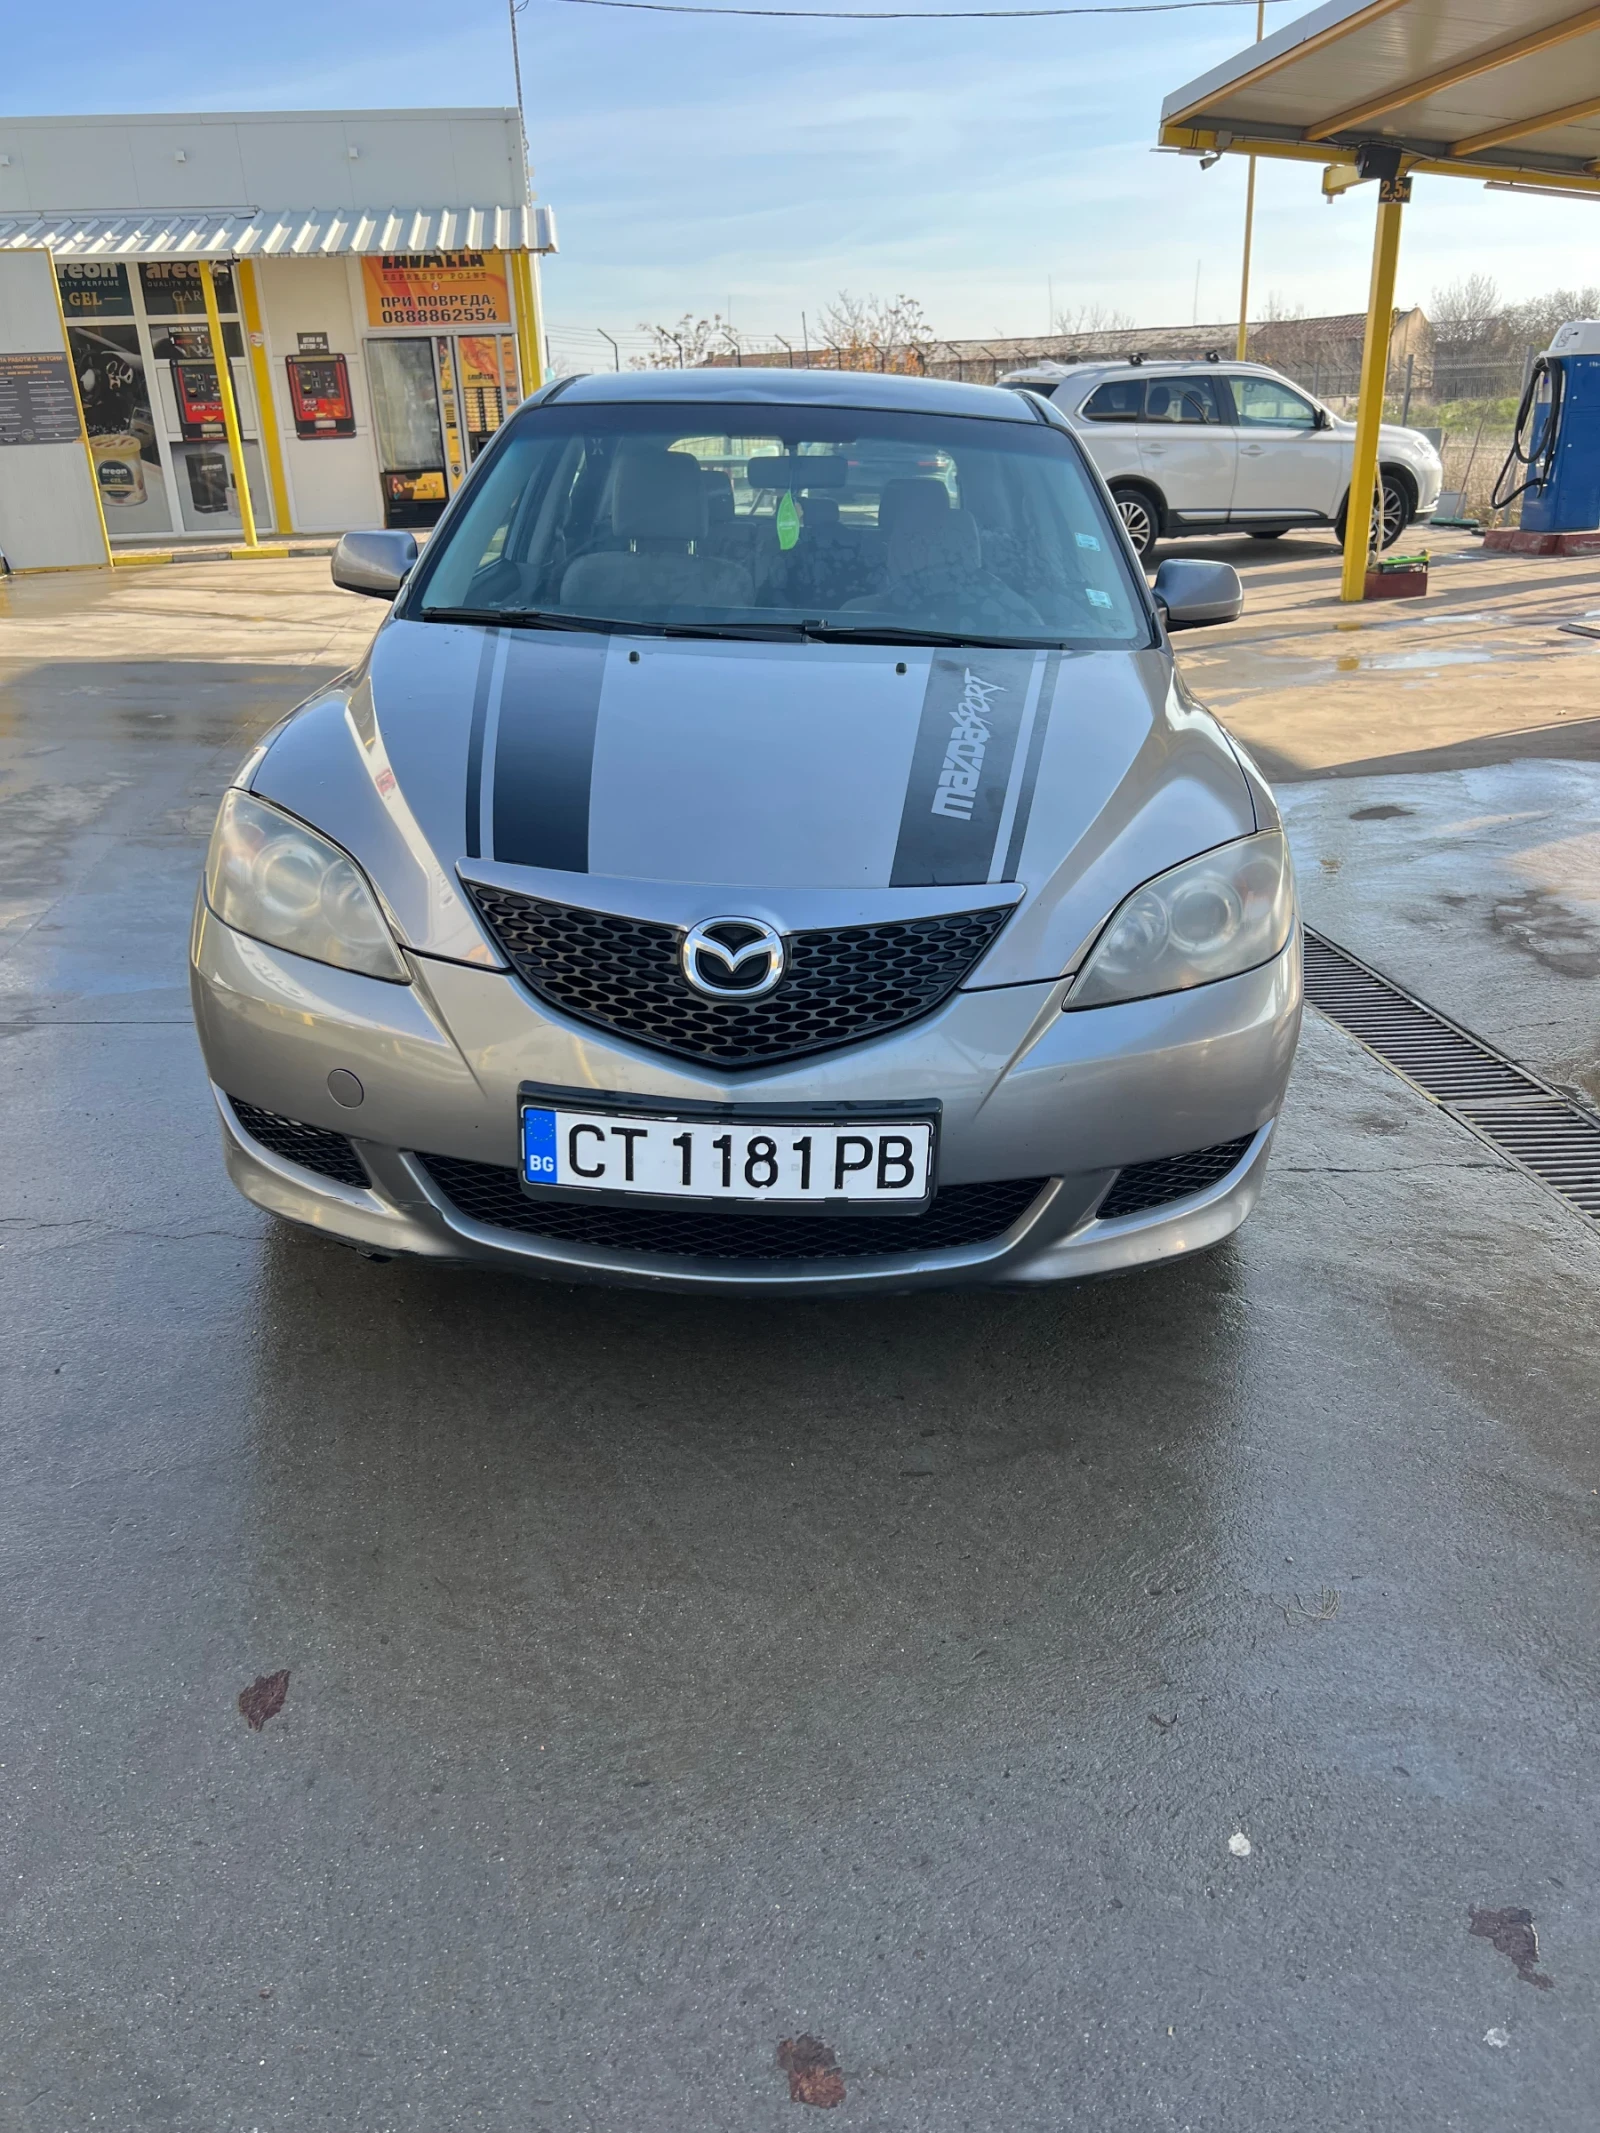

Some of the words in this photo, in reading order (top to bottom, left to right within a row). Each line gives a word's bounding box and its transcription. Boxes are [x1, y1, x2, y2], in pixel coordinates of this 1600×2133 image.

[57, 263, 118, 279] reon
[146, 262, 218, 279] areo
[383, 273, 443, 281] ESPRESSO
[68, 291, 103, 306] GEL
[381, 296, 412, 308] ПРИ
[417, 294, 496, 307] ПОВРЕДА:
[382, 308, 498, 324] 0888862554
[529, 1155, 554, 1172] BG
[568, 1123, 648, 1182] CT
[673, 1132, 812, 1189] 1181
[834, 1135, 915, 1190] PB
